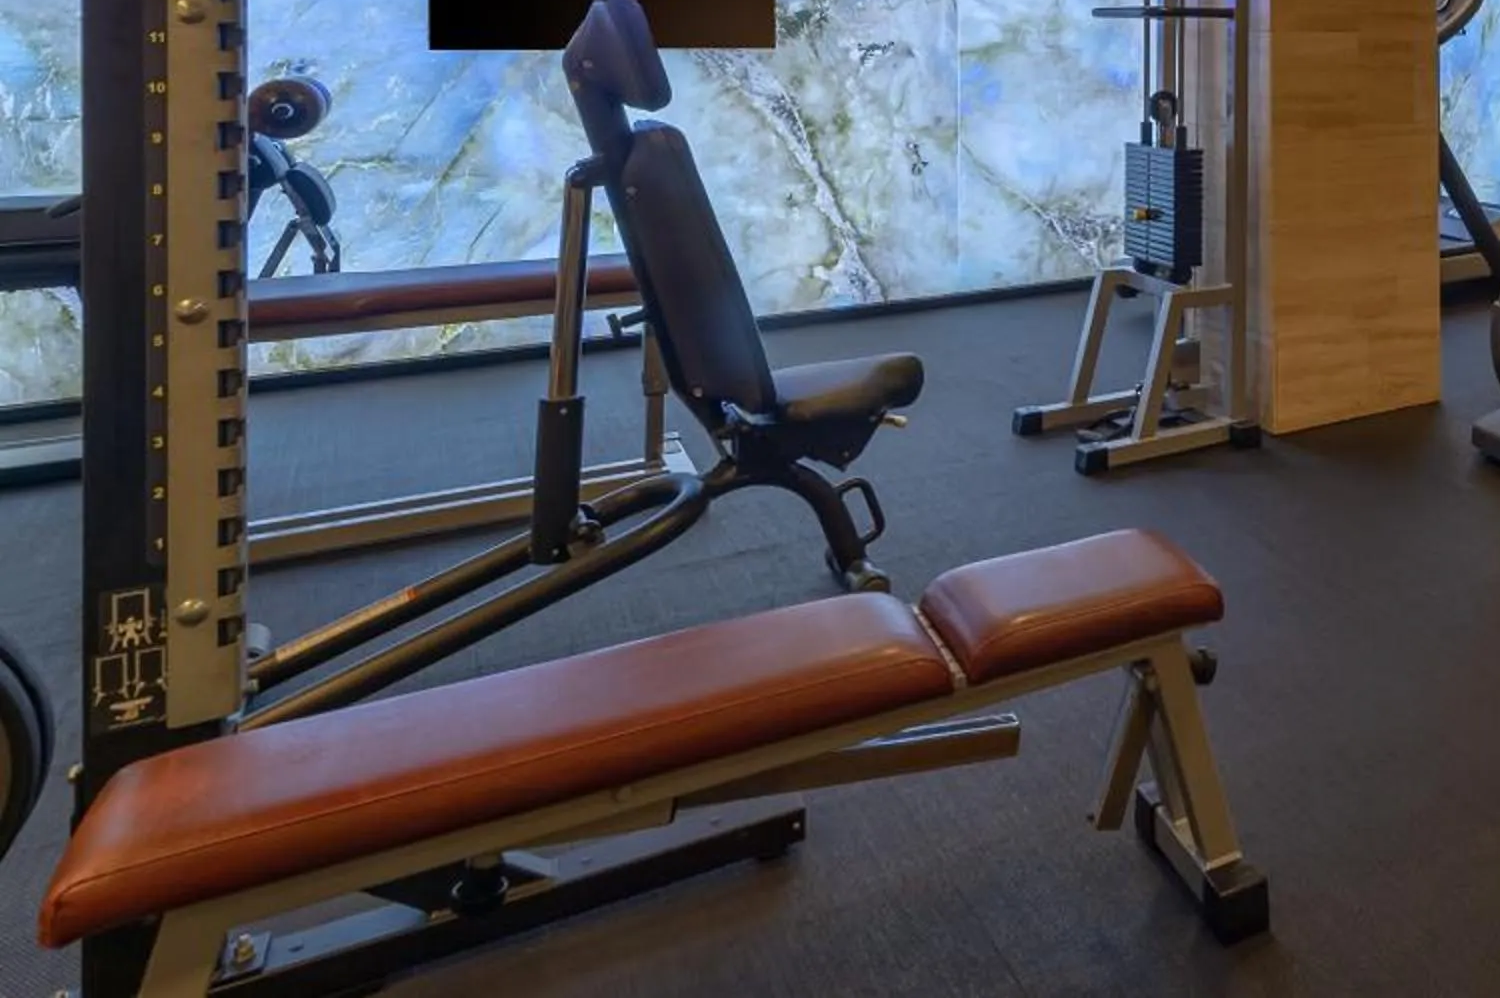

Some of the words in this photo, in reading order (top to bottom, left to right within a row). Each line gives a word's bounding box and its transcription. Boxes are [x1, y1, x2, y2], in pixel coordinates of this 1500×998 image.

[148, 31, 166, 43] 11
[147, 81, 166, 94] 10
[151, 132, 163, 144] 9
[152, 183, 163, 196] 8
[152, 233, 163, 246] 7
[152, 284, 164, 297] 6
[153, 334, 164, 347] 5
[152, 385, 164, 397] 4
[153, 436, 164, 449] 3
[153, 486, 164, 499] 2
